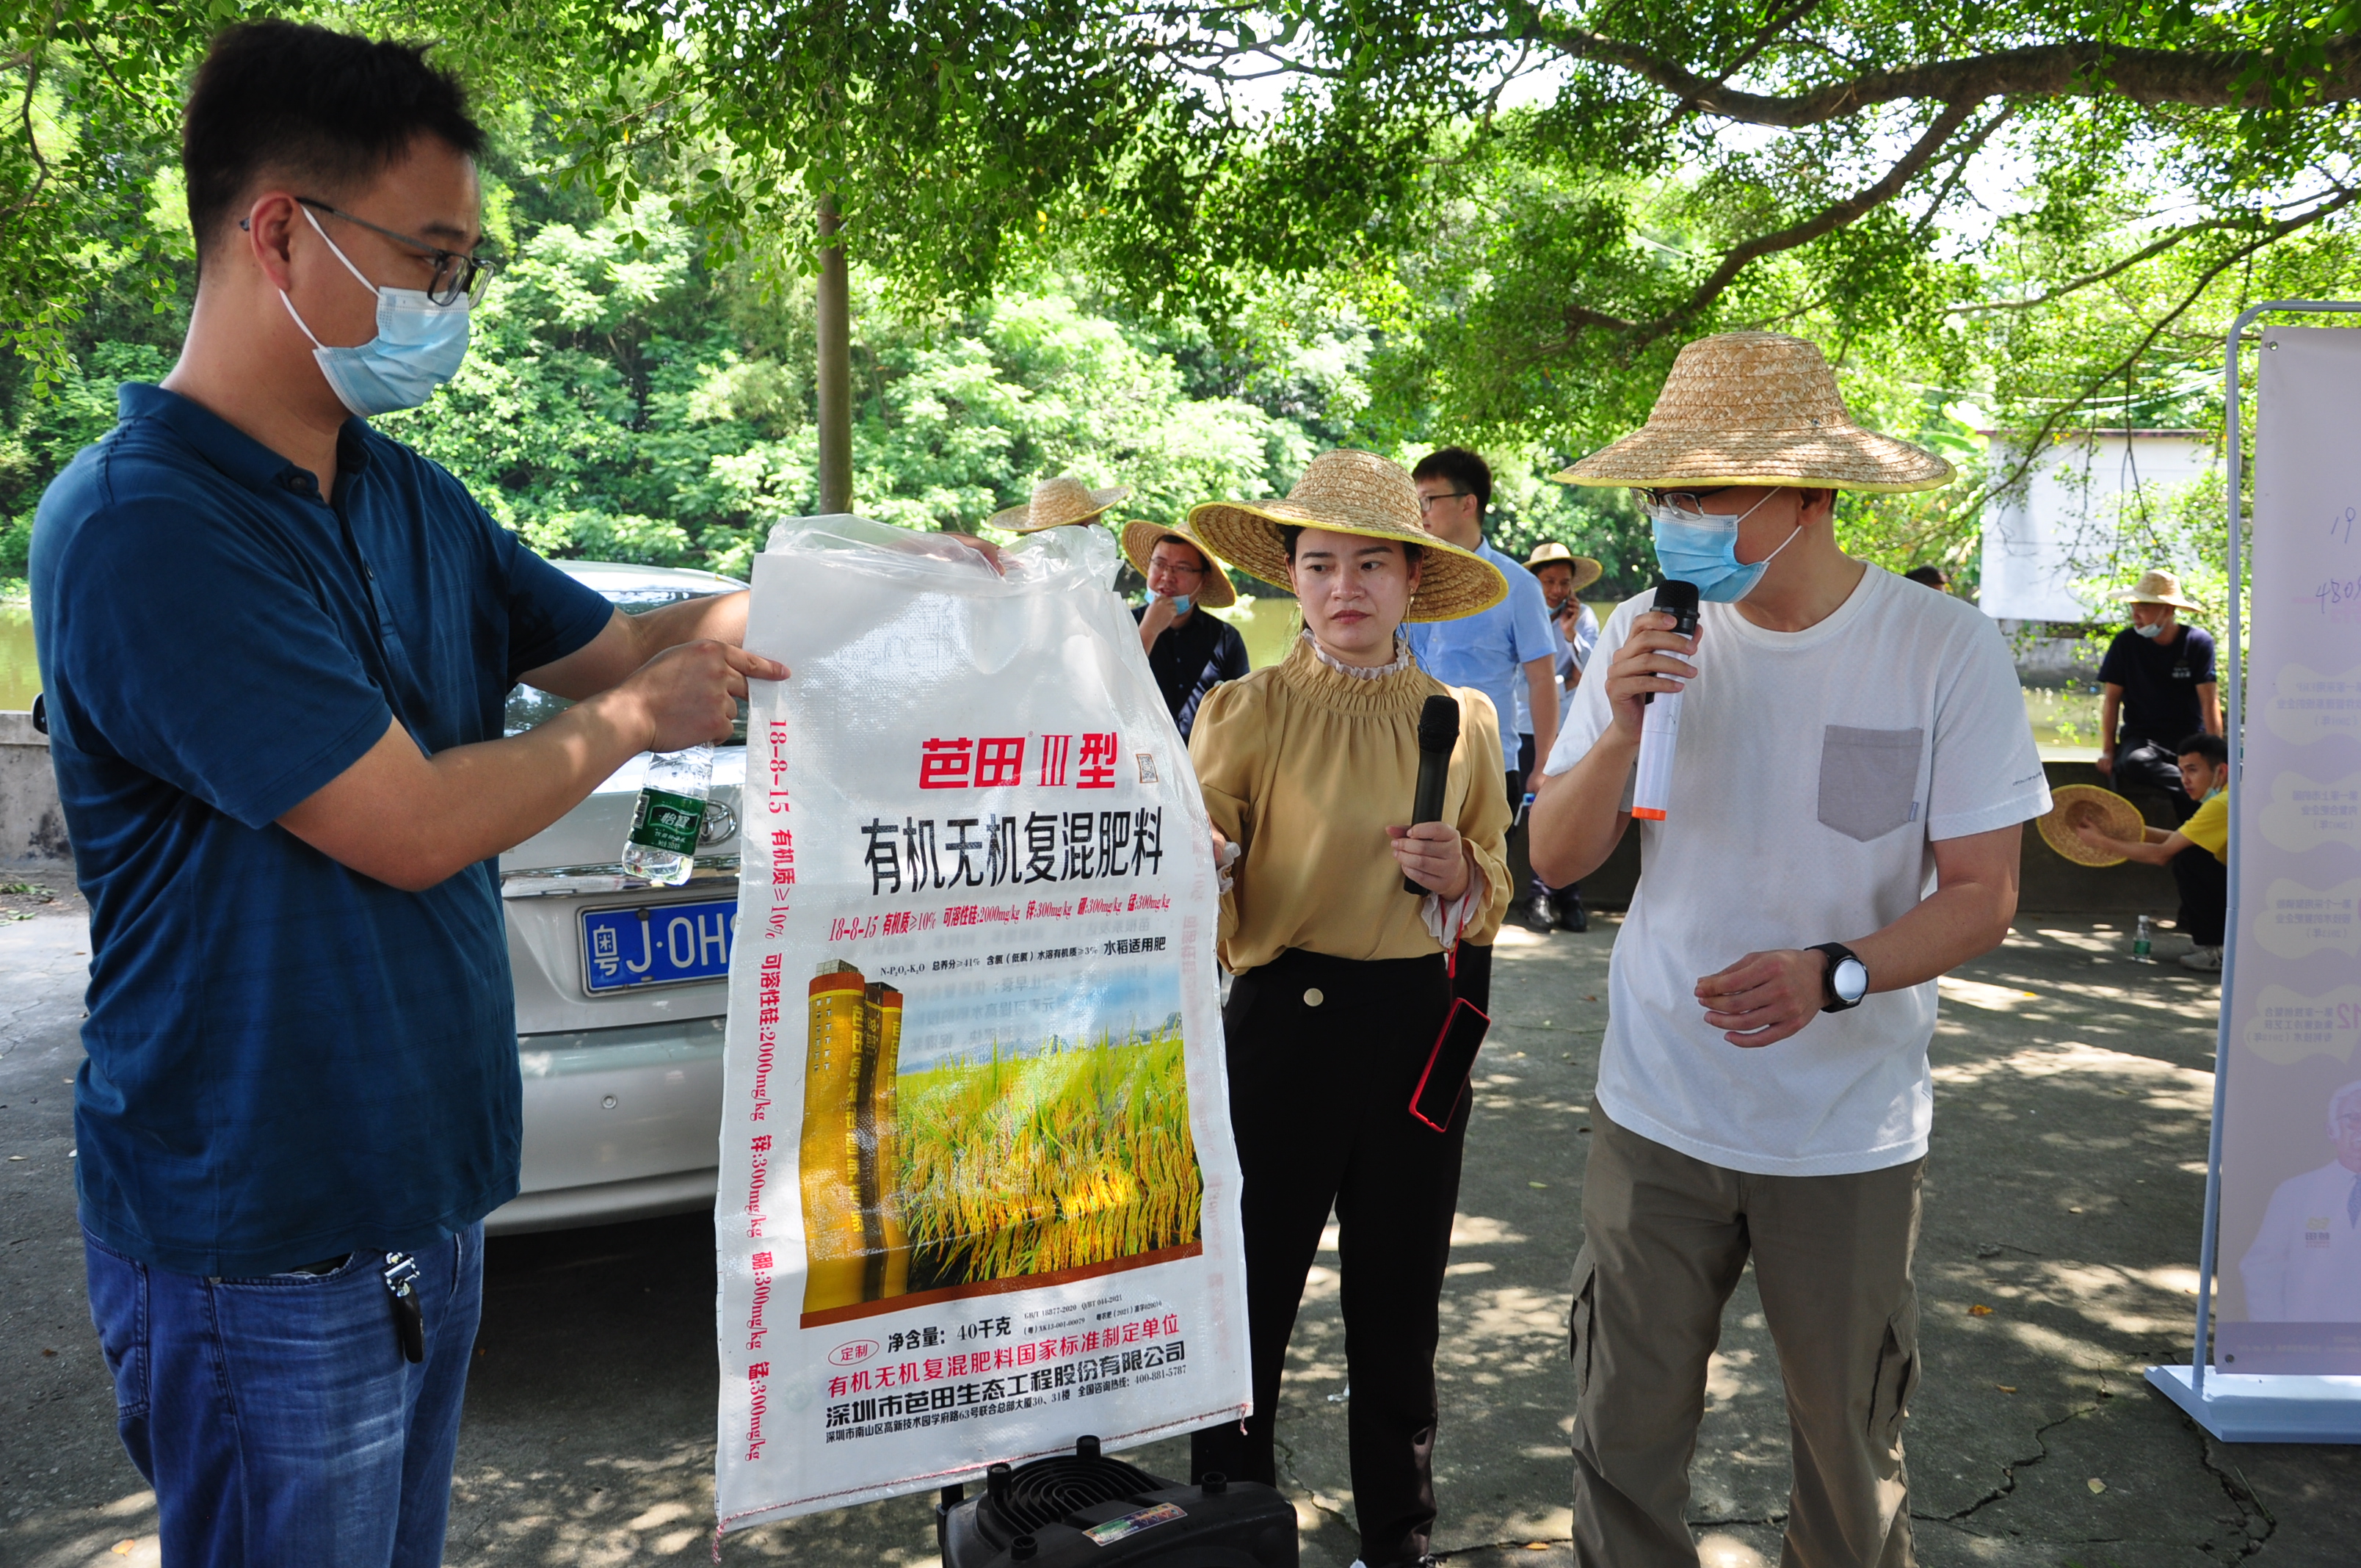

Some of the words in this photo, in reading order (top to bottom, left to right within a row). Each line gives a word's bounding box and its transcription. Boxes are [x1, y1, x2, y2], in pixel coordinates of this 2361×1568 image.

[768, 718, 791, 815] 18-8-15
[764, 829, 796, 940] 有机质≥10%
[860, 805, 1164, 896] 有机无机复混肥料
[828, 915, 879, 942] 18-8-15
[882, 911, 937, 937] 有机质≥10%
[1103, 936, 1167, 957] 水稻适用肥
[825, 1340, 1186, 1429] 深圳市芭田生态工程股份有限公司
[827, 1313, 1180, 1399] 有机无机复混肥料国家标准制定单位
[840, 1343, 869, 1362] 定制
